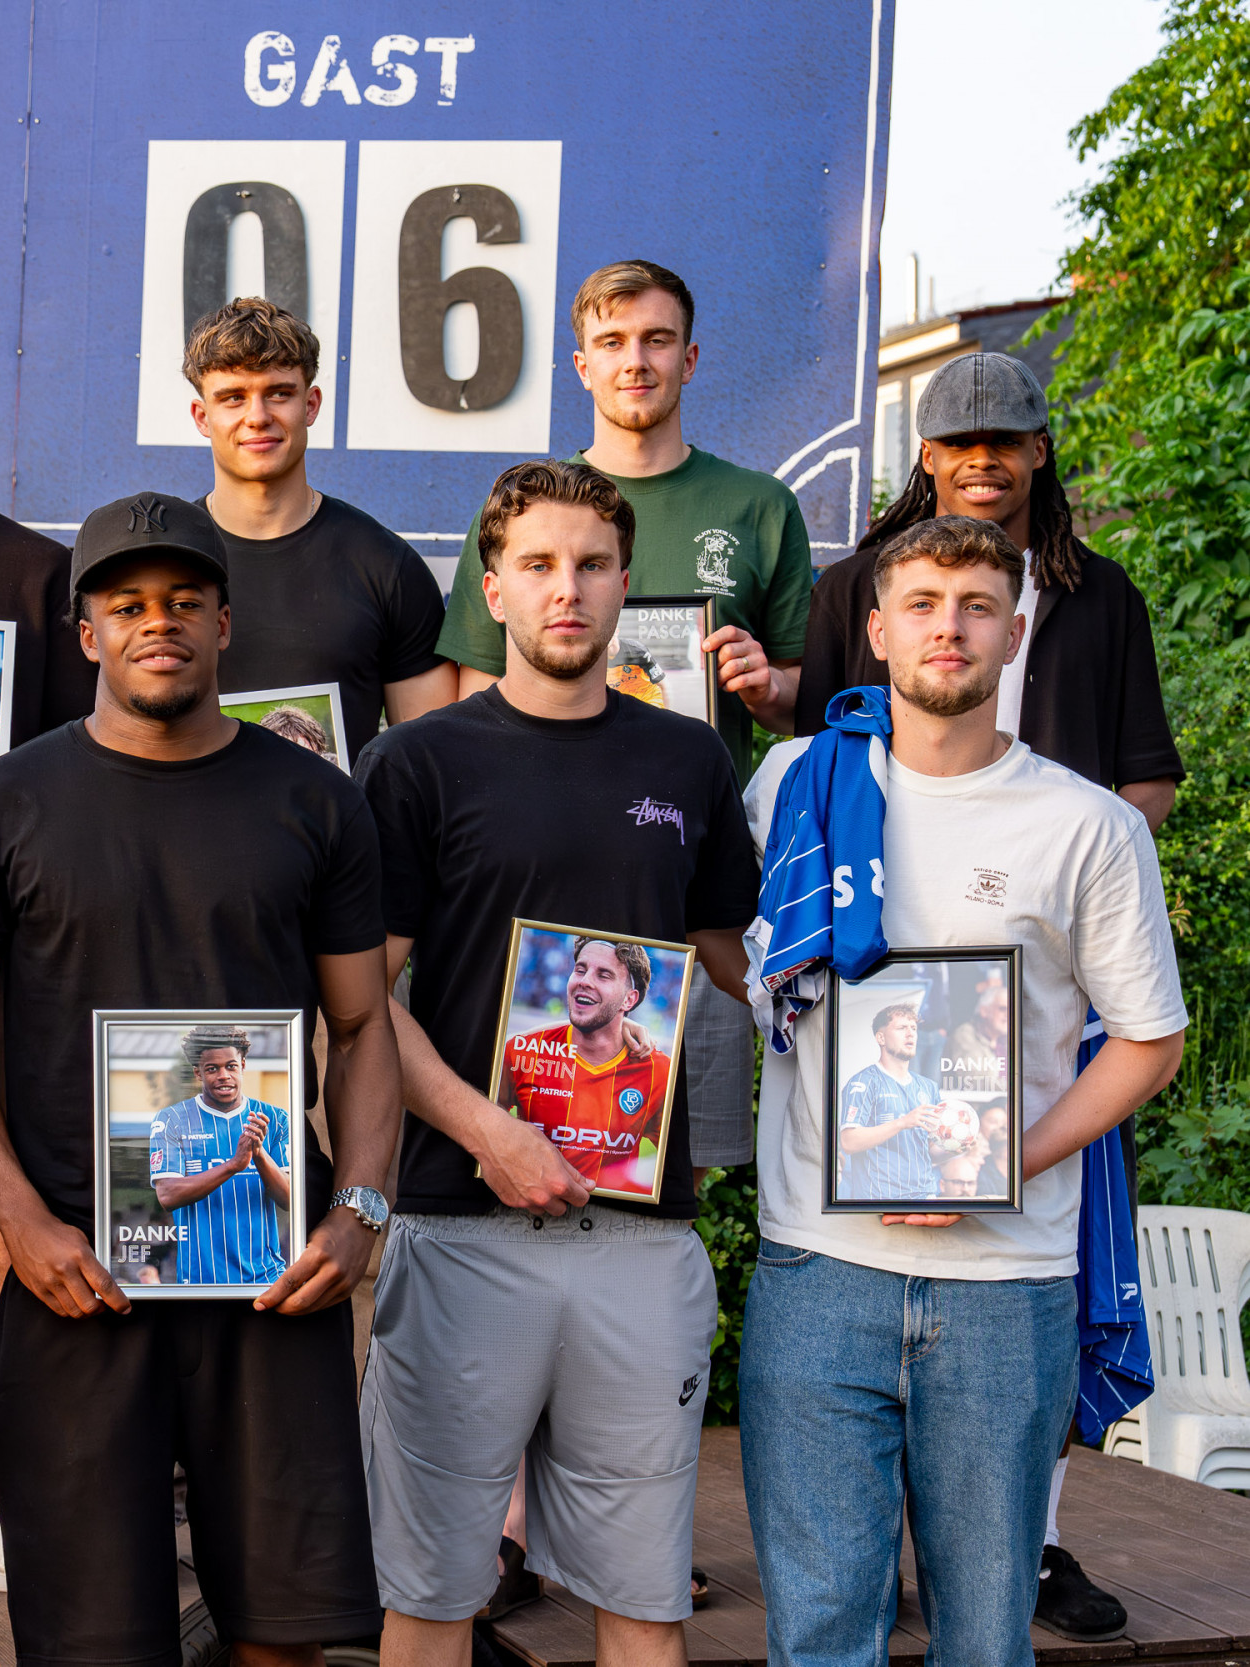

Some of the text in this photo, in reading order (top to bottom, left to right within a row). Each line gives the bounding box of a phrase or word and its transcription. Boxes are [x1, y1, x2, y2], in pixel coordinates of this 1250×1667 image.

[244, 30, 476, 107] GAST
[637, 608, 694, 622] DANKE
[637, 623, 698, 640] PASCA
[513, 1035, 579, 1060] DANKE
[510, 1054, 577, 1081] JUSTIN
[940, 1056, 1007, 1072] DANKE
[539, 1087, 574, 1098] PATRICK
[188, 1133, 215, 1141] PATRICK
[118, 1225, 188, 1242] DANKE
[117, 1244, 151, 1264] JEF
